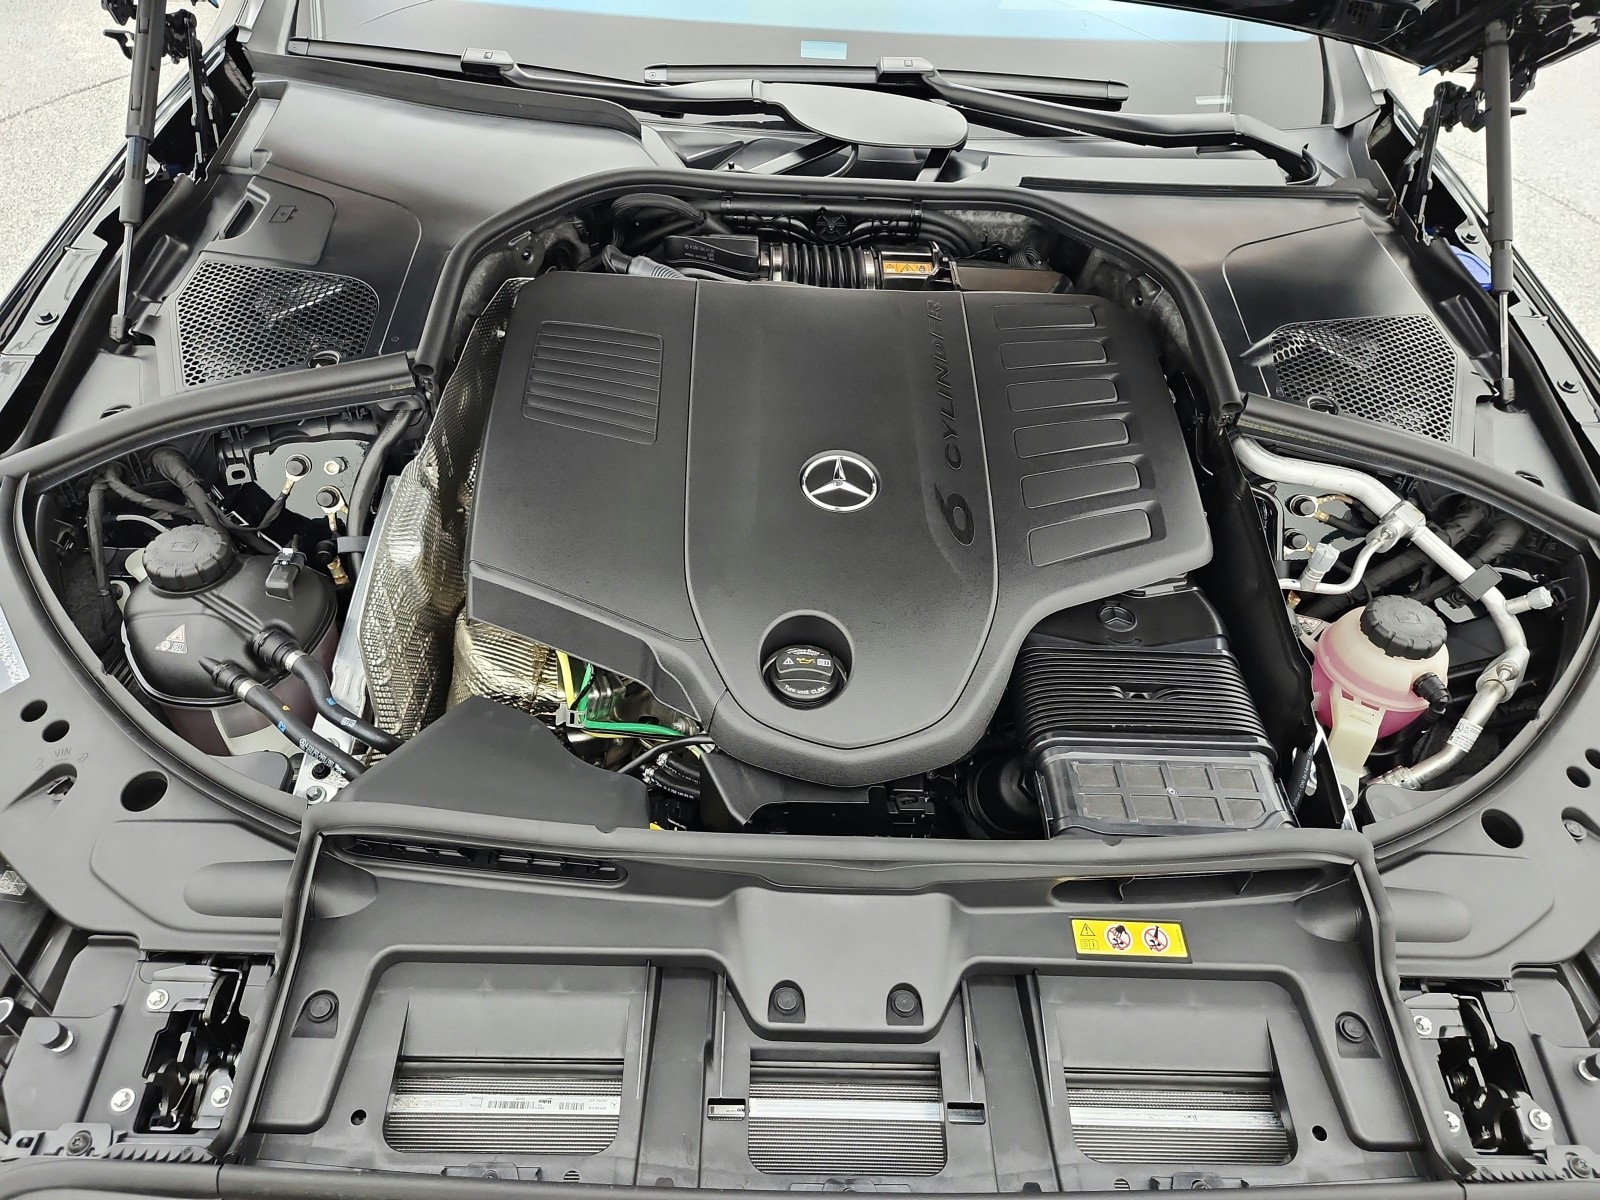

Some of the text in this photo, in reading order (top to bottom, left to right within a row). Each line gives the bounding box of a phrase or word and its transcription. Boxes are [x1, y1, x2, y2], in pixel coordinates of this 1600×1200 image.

[927, 299, 975, 546] 6 CYLINDER
[784, 684, 796, 693] Turn
[811, 686, 827, 695] CLICK
[54, 748, 72, 757] VIN
